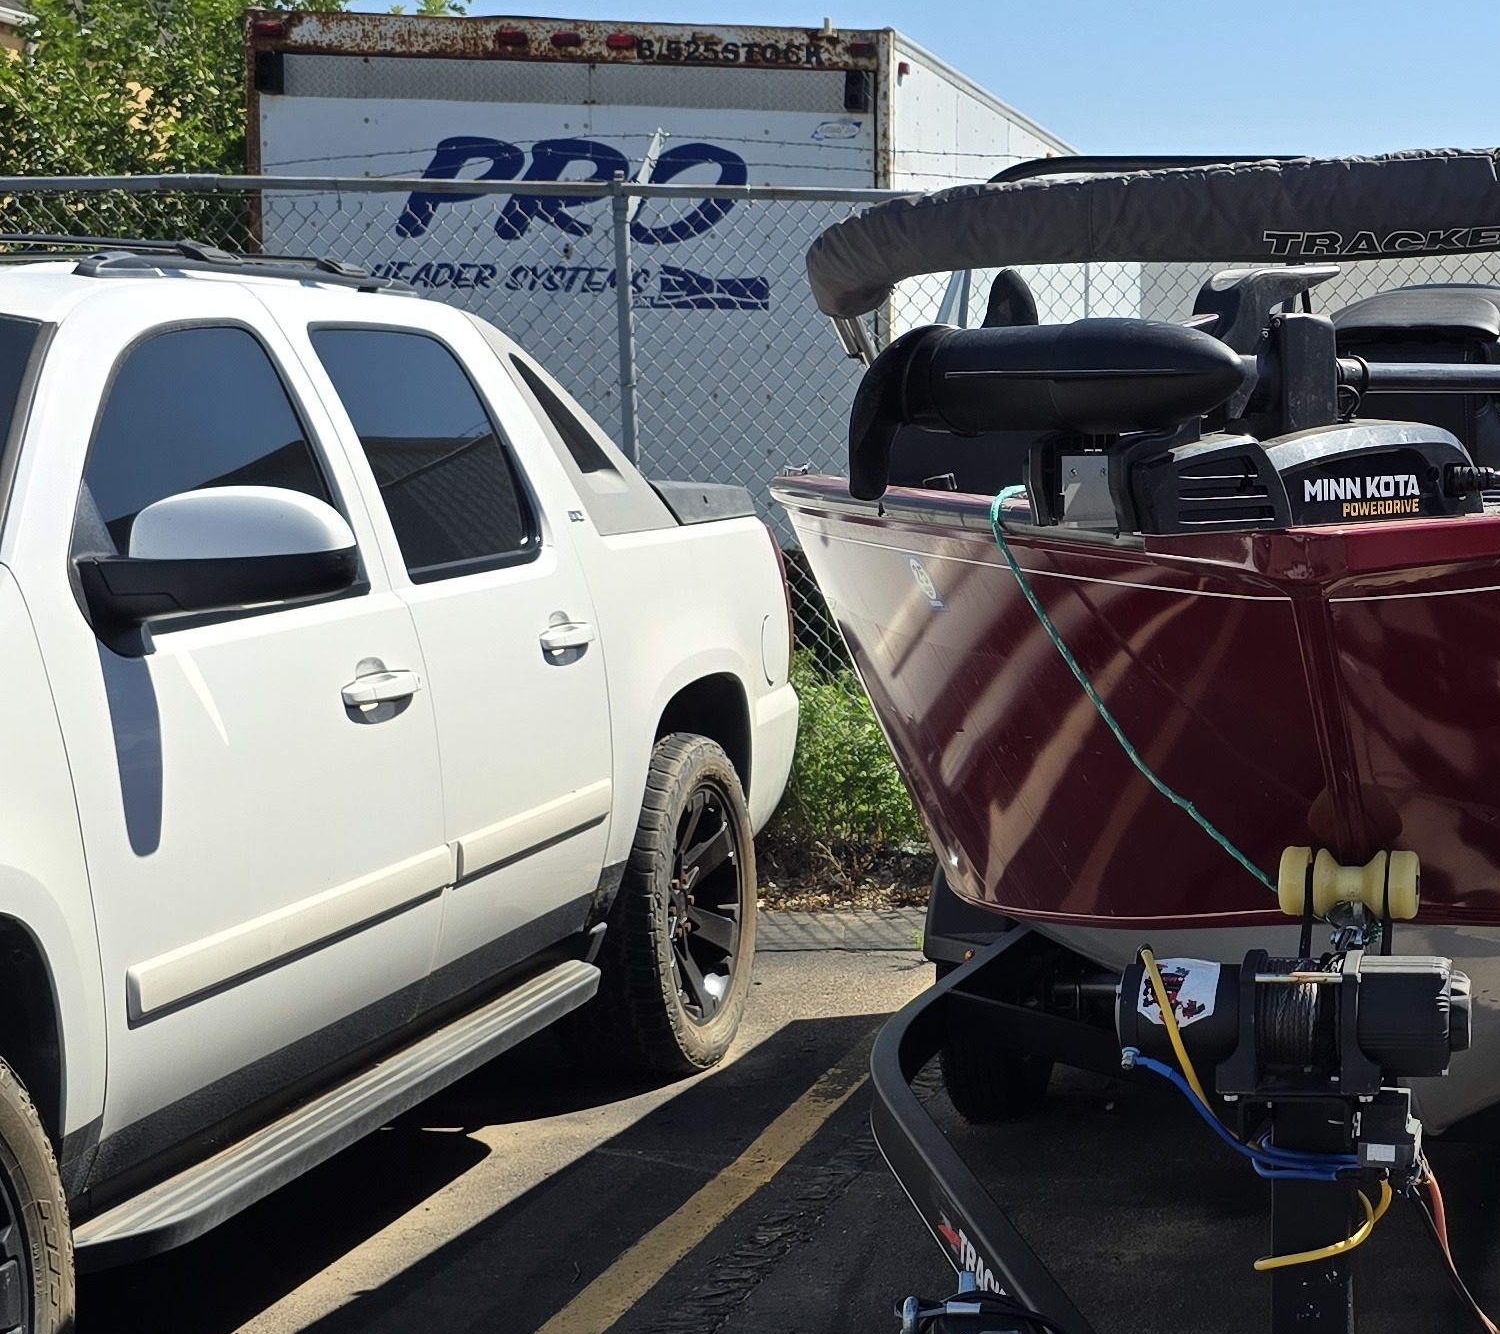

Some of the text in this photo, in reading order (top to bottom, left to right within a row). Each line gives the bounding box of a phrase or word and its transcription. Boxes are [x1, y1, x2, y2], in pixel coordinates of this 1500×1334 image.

[395, 136, 747, 244] PRO
[1303, 474, 1420, 502] MINN KOTA
[1342, 498, 1420, 517] POWERDRIVE
